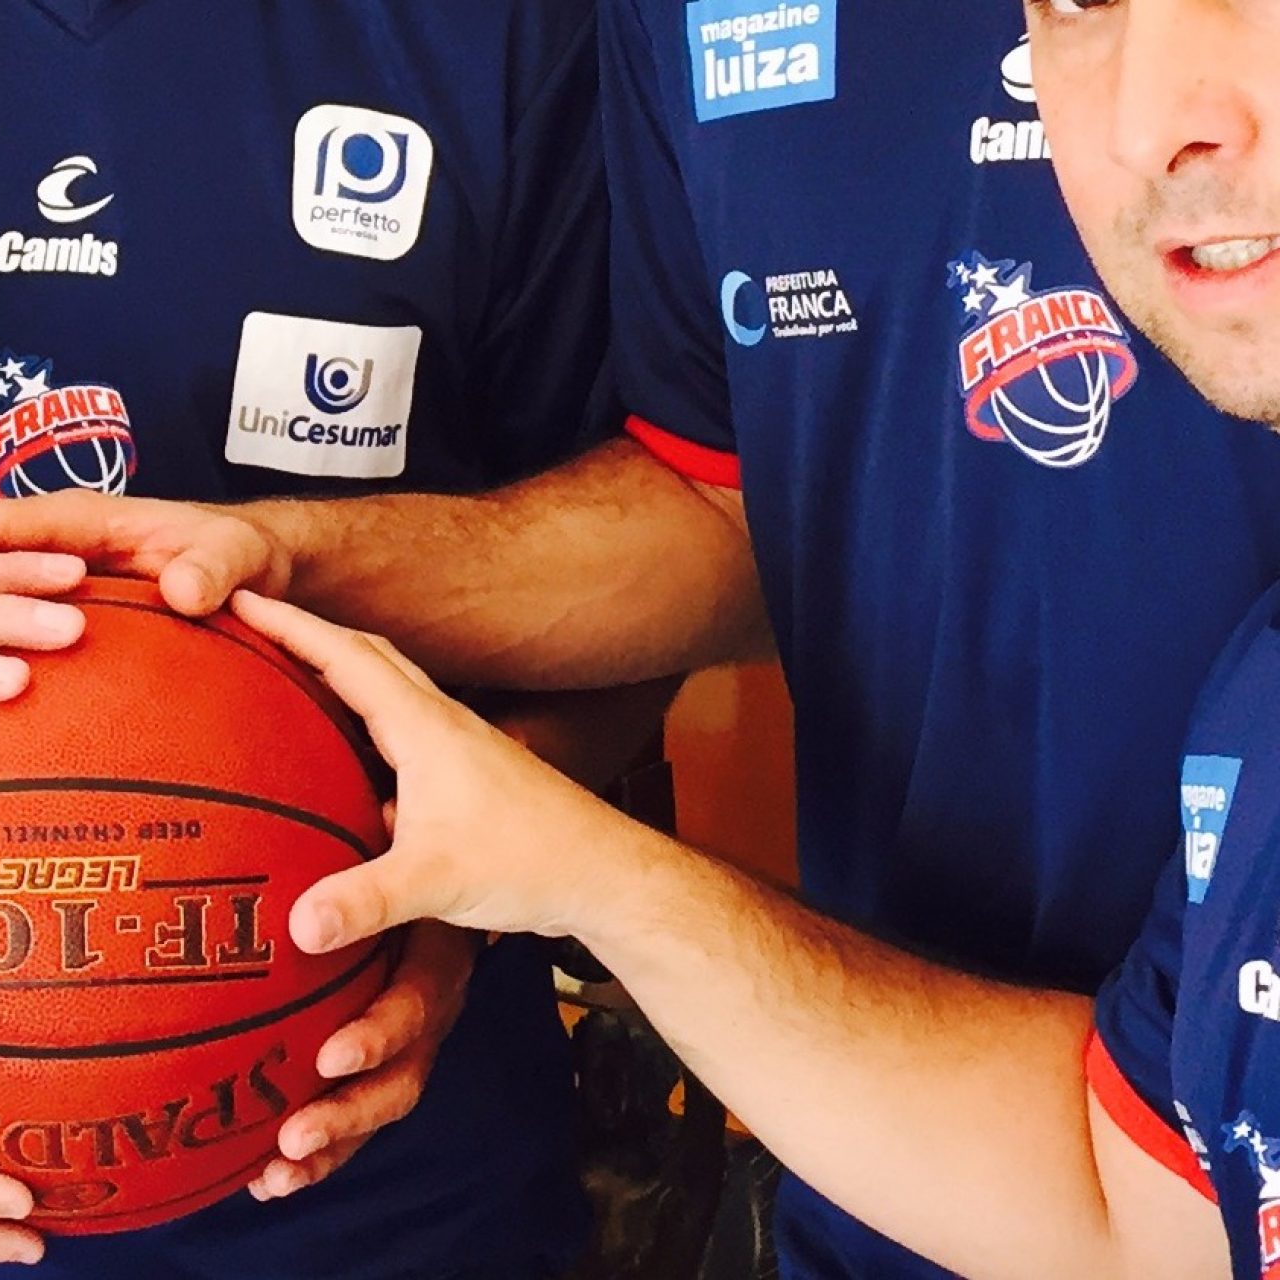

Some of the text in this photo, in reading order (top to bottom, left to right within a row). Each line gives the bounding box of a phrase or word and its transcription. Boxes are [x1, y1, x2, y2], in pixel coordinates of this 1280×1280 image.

[700, 2, 820, 44] magazine
[704, 40, 819, 100] luiza
[970, 116, 1052, 164] Cam
[310, 206, 401, 233] perfetto
[768, 290, 852, 323] FRANCA
[958, 290, 1123, 391] FRANCA
[238, 405, 402, 448] UniCesumar
[3, 823, 125, 844] CHANNEL
[138, 820, 203, 841] DEEP
